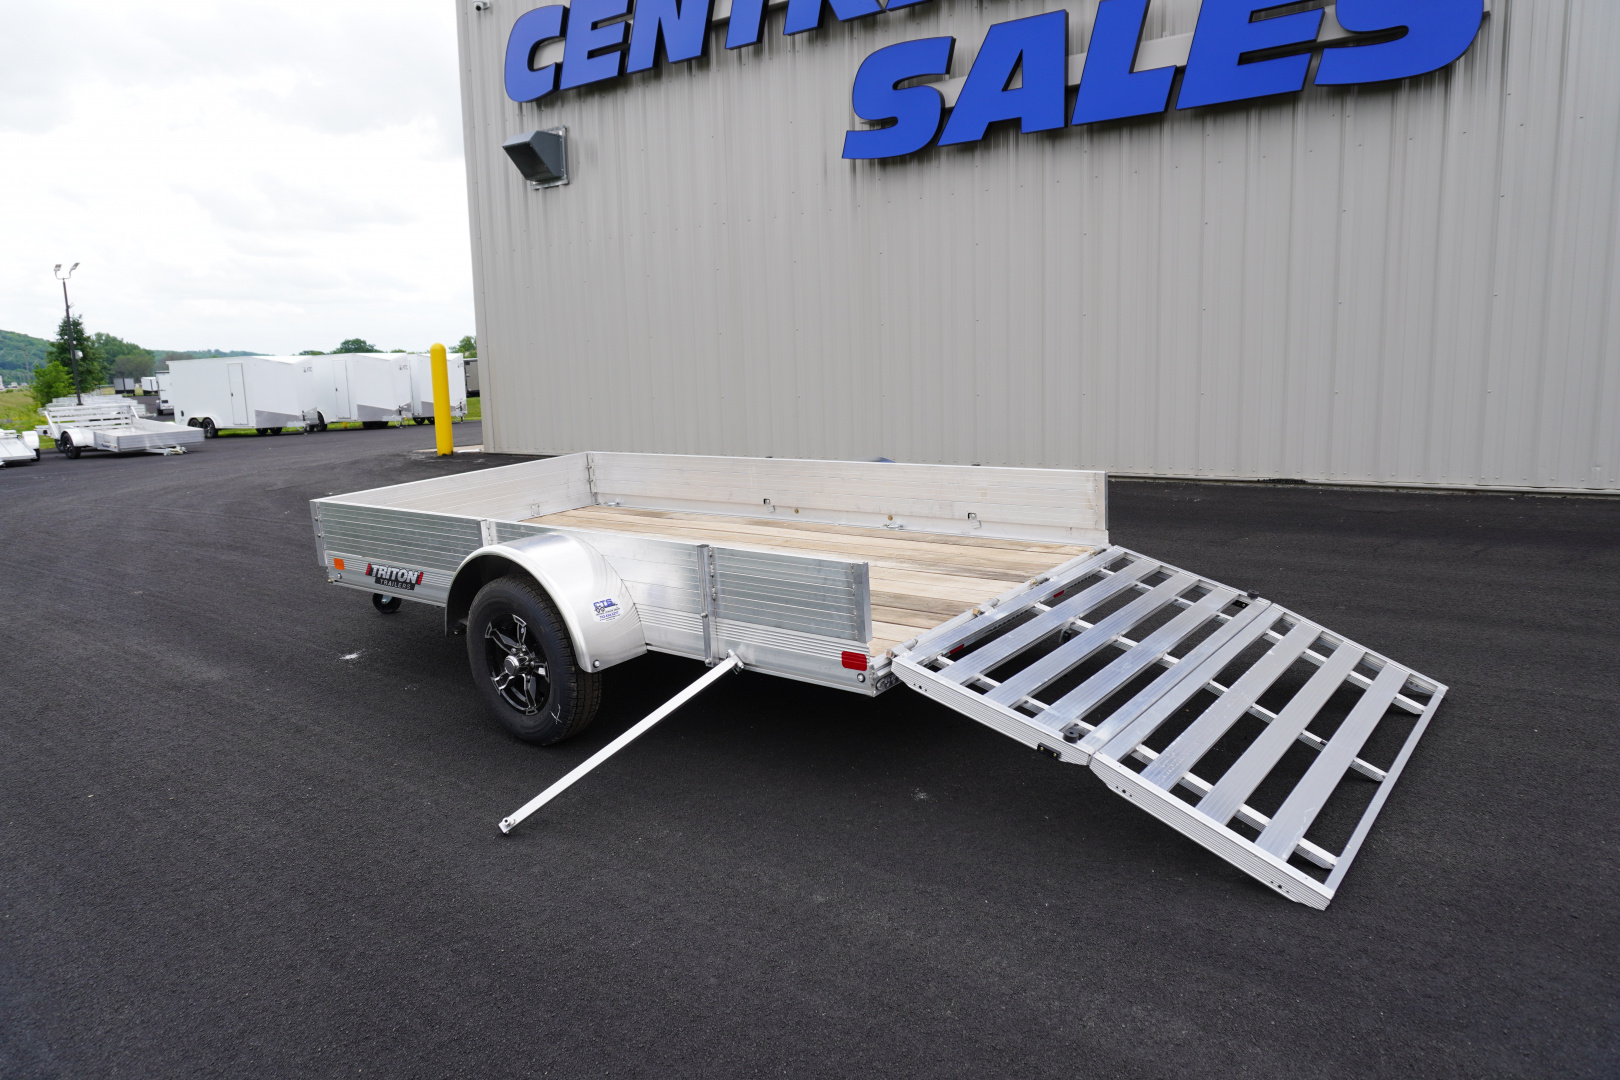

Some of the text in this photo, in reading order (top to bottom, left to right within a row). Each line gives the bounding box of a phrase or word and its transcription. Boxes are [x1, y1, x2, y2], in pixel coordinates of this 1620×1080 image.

[842, 0, 1488, 160] SALES
[370, 564, 418, 584] TRITON
[380, 579, 411, 590] TRAILERS
